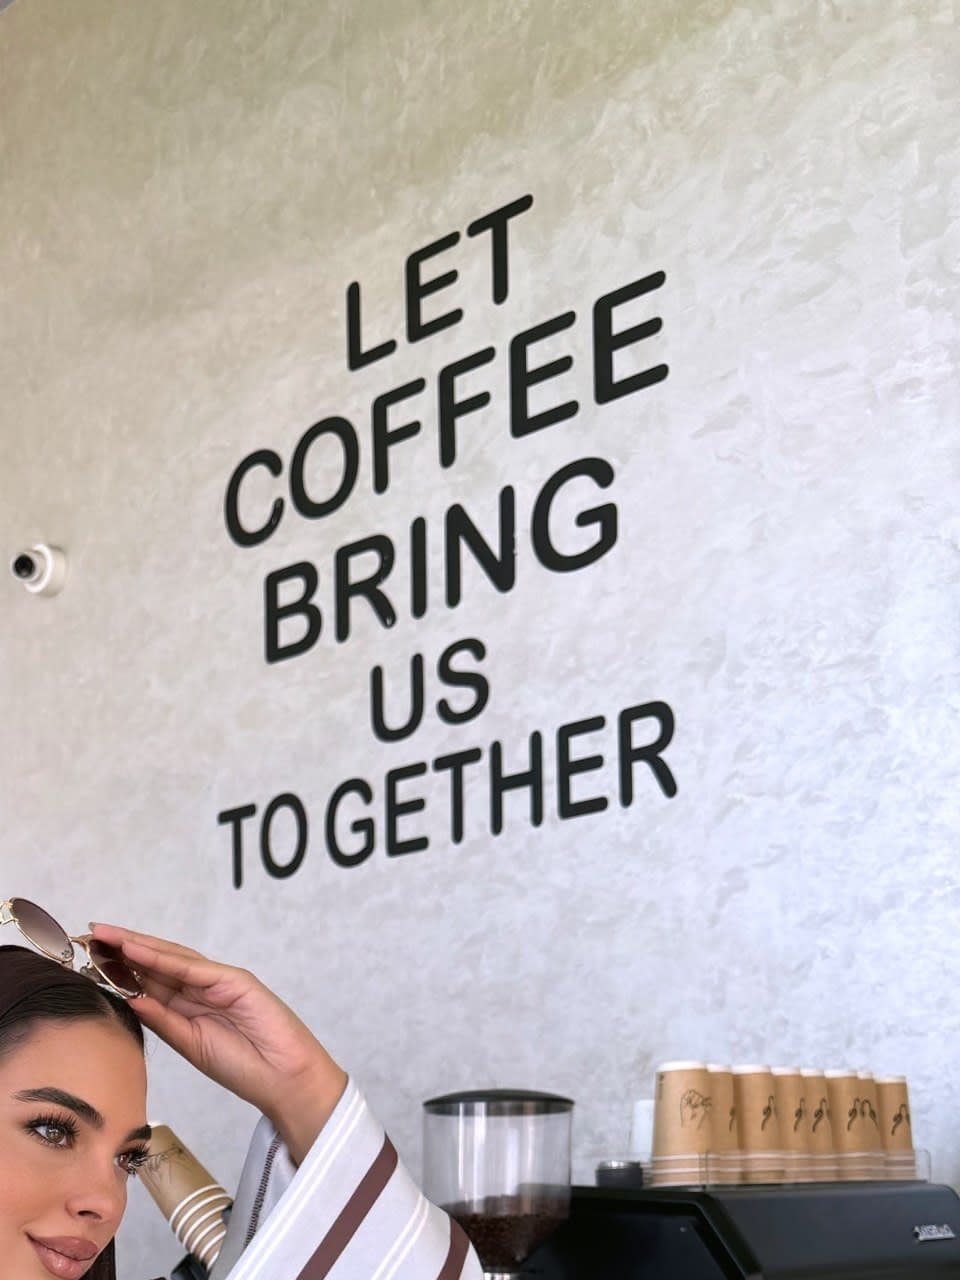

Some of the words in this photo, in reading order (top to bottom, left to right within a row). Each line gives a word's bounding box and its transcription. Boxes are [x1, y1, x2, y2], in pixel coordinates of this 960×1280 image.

[346, 194, 535, 372] LET
[224, 270, 670, 548] COFFEE
[264, 456, 618, 664] BRING
[370, 637, 490, 743] US
